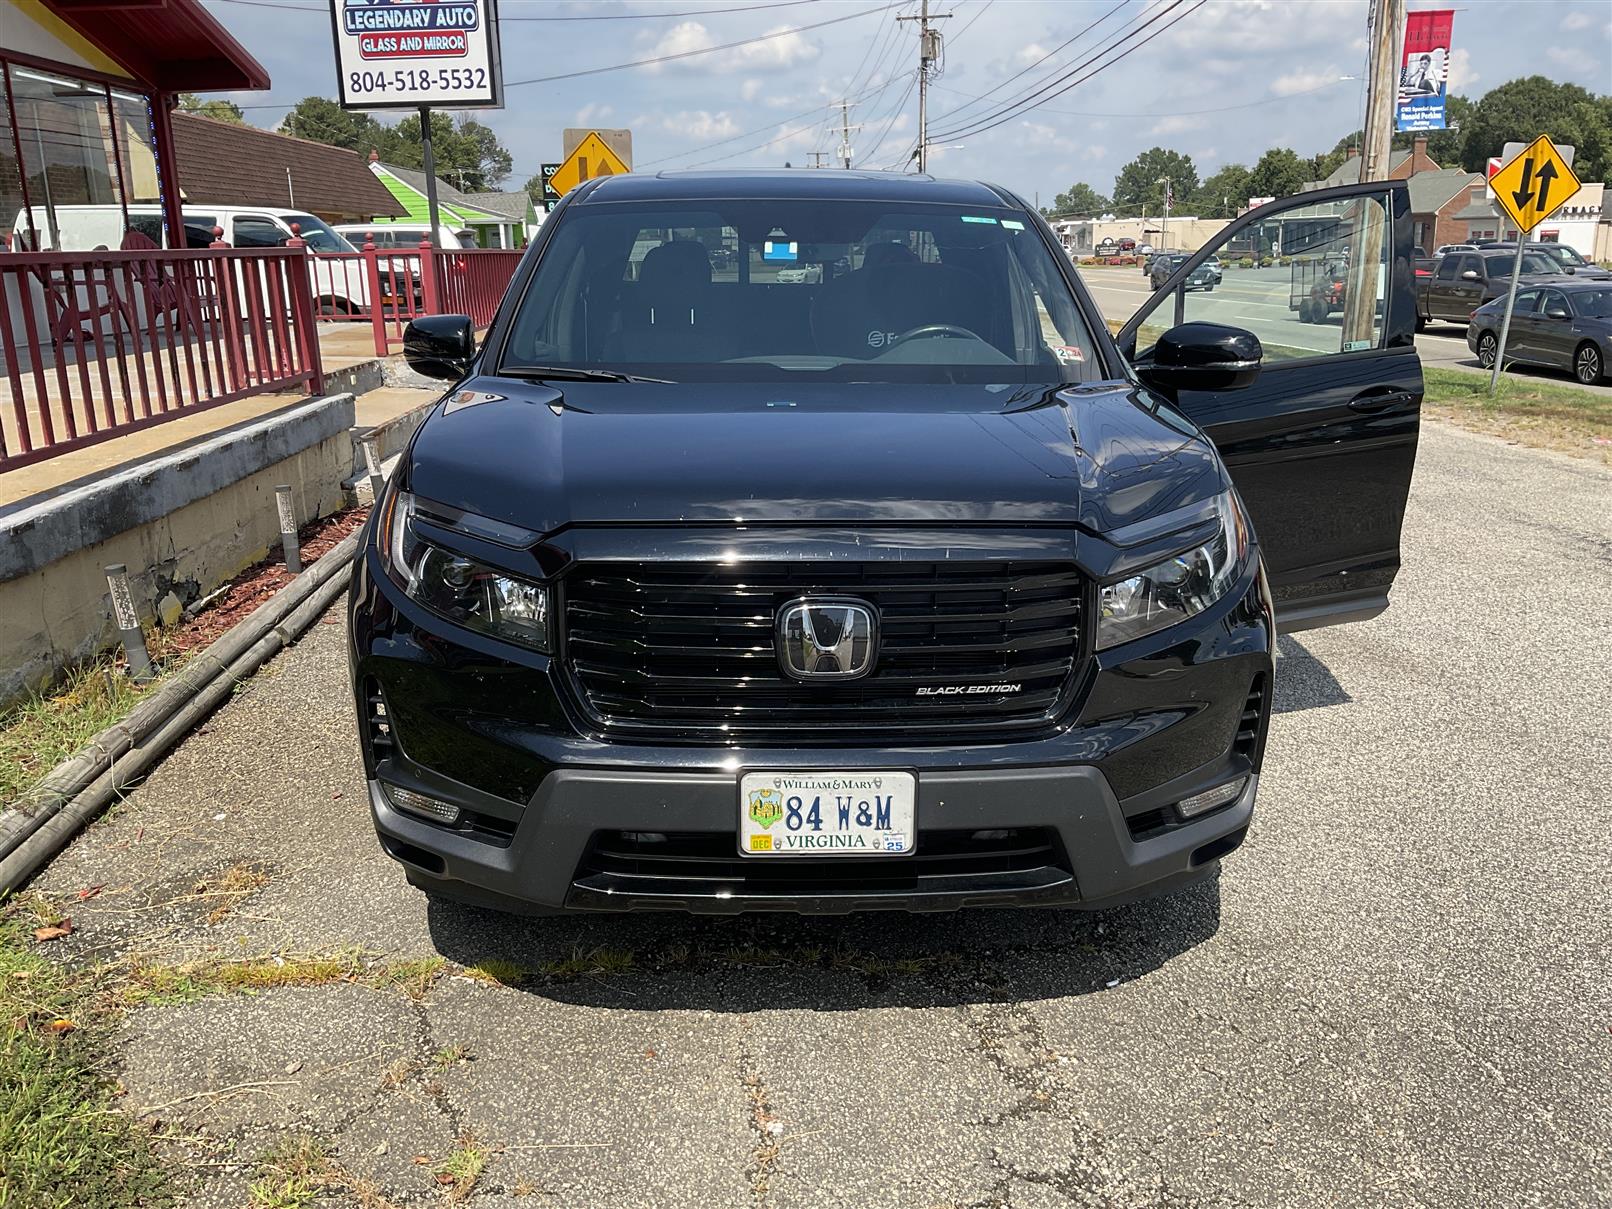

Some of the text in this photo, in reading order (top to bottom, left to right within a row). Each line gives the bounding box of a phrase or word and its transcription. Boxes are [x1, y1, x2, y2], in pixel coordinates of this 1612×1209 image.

[346, 7, 476, 30] LEGENDARY AUTO
[362, 35, 465, 53] GLASS AND MIRROR
[350, 68, 487, 93] 804-518-5532
[1058, 348, 1066, 357] 2
[915, 684, 1022, 696] BLACK EDITION
[785, 795, 894, 832] 84 W&M
[752, 839, 769, 849] DEC
[786, 834, 866, 848] VIRGINIA
[886, 842, 903, 851] 25
